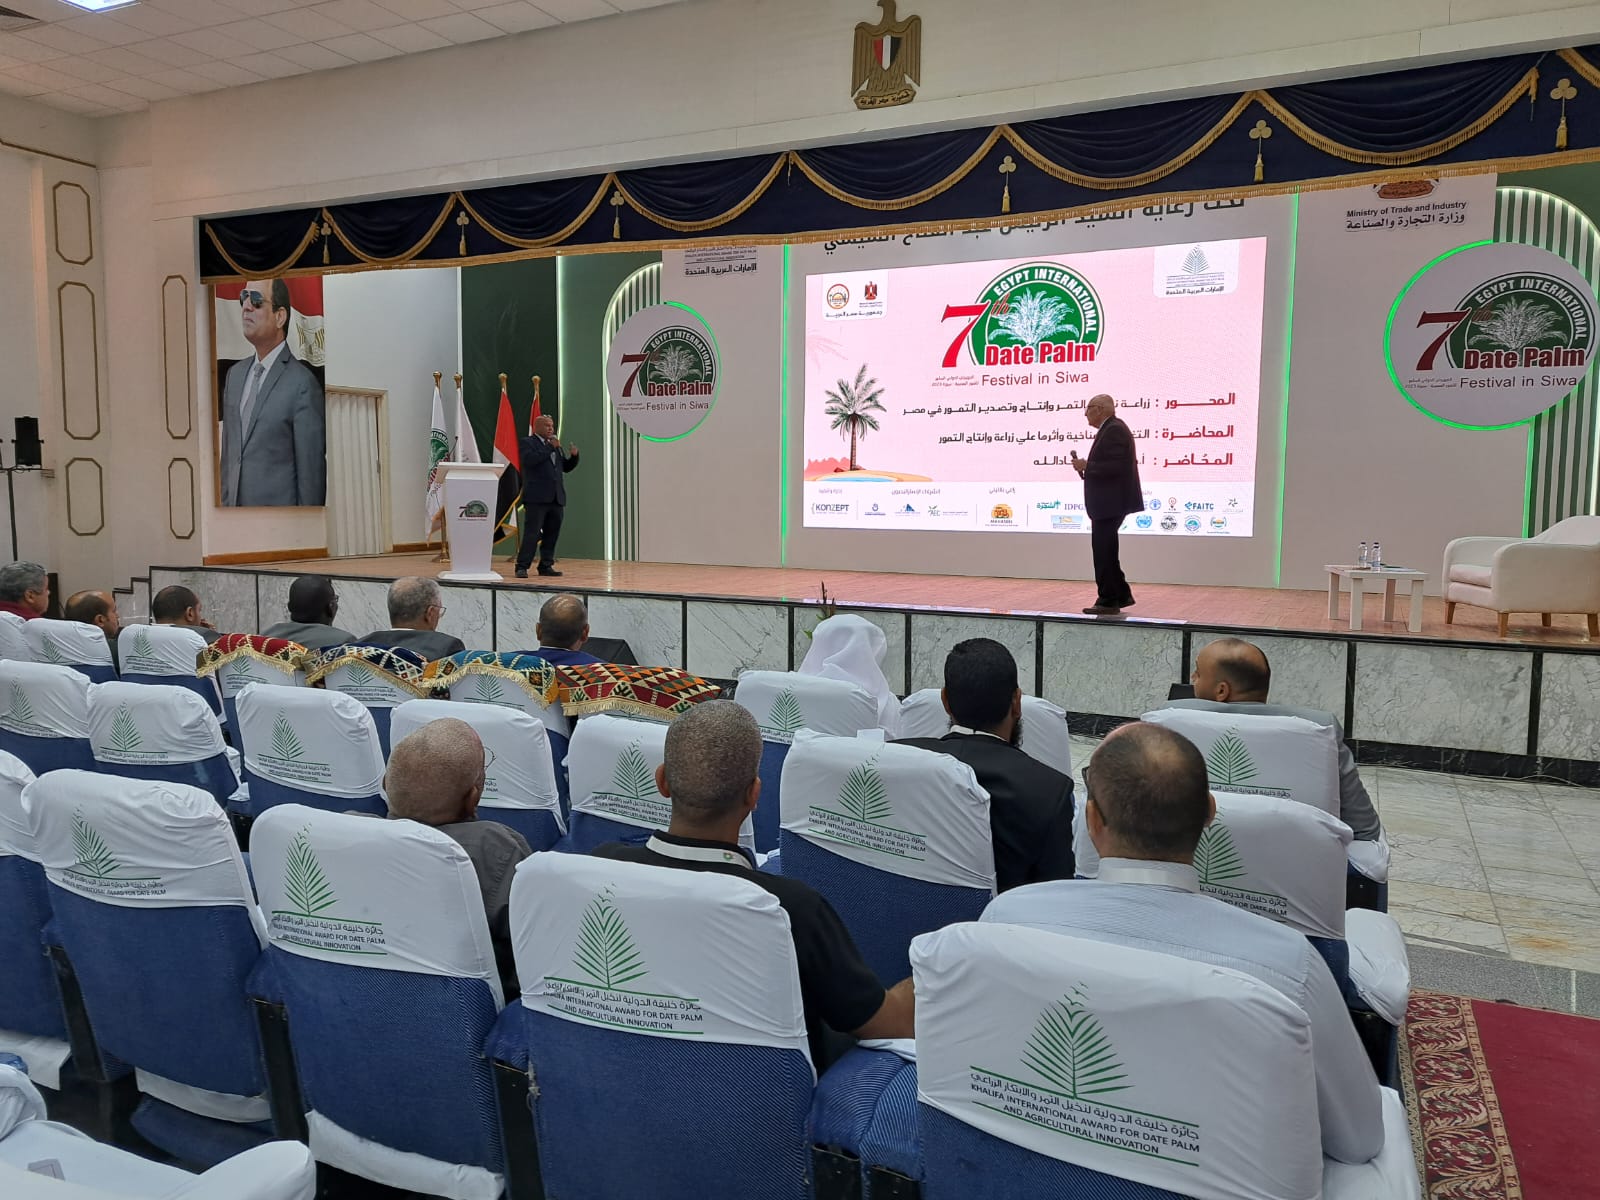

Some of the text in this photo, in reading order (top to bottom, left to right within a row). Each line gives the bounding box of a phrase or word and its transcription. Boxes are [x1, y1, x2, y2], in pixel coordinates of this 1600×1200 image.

[1347, 209, 1378, 217] Ministry
[1432, 202, 1466, 210] Industry
[1347, 212, 1465, 229] وزارة التجارة والصناعة
[993, 268, 1097, 334] EGYPT INTERNATIONAL
[1475, 279, 1515, 304] EGYPT
[1521, 278, 1587, 340] INTERNATIONAL
[941, 301, 990, 368] 7
[1416, 307, 1472, 371] 7
[650, 332, 672, 349] EGYPT
[675, 330, 713, 375] INTERNATIONAL
[985, 341, 1095, 366] Date Palm
[1464, 346, 1585, 369] Date Palm
[621, 351, 650, 397] 7
[982, 373, 1032, 386] Festival
[1038, 373, 1049, 384] in
[1055, 371, 1089, 383] Siwa
[647, 381, 712, 397] Date Palm
[1460, 376, 1516, 389] Festival
[1521, 375, 1534, 387] in
[1541, 375, 1577, 386] Siwa
[647, 402, 676, 411] Festival
[689, 401, 709, 409] Siwa
[1019, 401, 1054, 413] وإنتاج
[1121, 398, 1150, 408] زراعة
[1165, 392, 1235, 409] المحور
[903, 407, 926, 416] مصر
[927, 405, 942, 417] في
[944, 403, 976, 415] التمور
[978, 404, 1017, 416] وتصدير
[939, 432, 964, 444] التمور
[966, 434, 992, 444] وإنتاج
[994, 432, 1014, 442] زراعة
[1162, 425, 1234, 440] المحاضرة
[828, 823, 864, 837] INTERNATIONAL
[866, 833, 884, 842] AWARD
[885, 838, 896, 846] FOR
[1218, 890, 1244, 899] الدولية
[365, 926, 383, 935] جائزة
[324, 941, 361, 950] INNOVATION
[585, 990, 600, 999] التمر
[601, 993, 621, 1002] لنخيل
[623, 996, 651, 1007] الدولية
[565, 995, 613, 1013] INTERNATIONAL
[614, 1007, 641, 1016] AWARD
[642, 1011, 658, 1019] FOR
[659, 1012, 679, 1020] DATE
[653, 1000, 677, 1009] خليفة
[680, 1000, 701, 1011] جائزة
[565, 1004, 673, 1030] AND AGRICULTURAL INNOVATION
[970, 1072, 1199, 1140] جائزة خليفة الدولية لنخيل التمر والابتكار الزراعي
[971, 1084, 1200, 1153] KHALIFA INTERNATIONAL AWARD FOR DATE PALM
[1003, 1104, 1159, 1154] AND AGRICULTURAL INNOVATION
